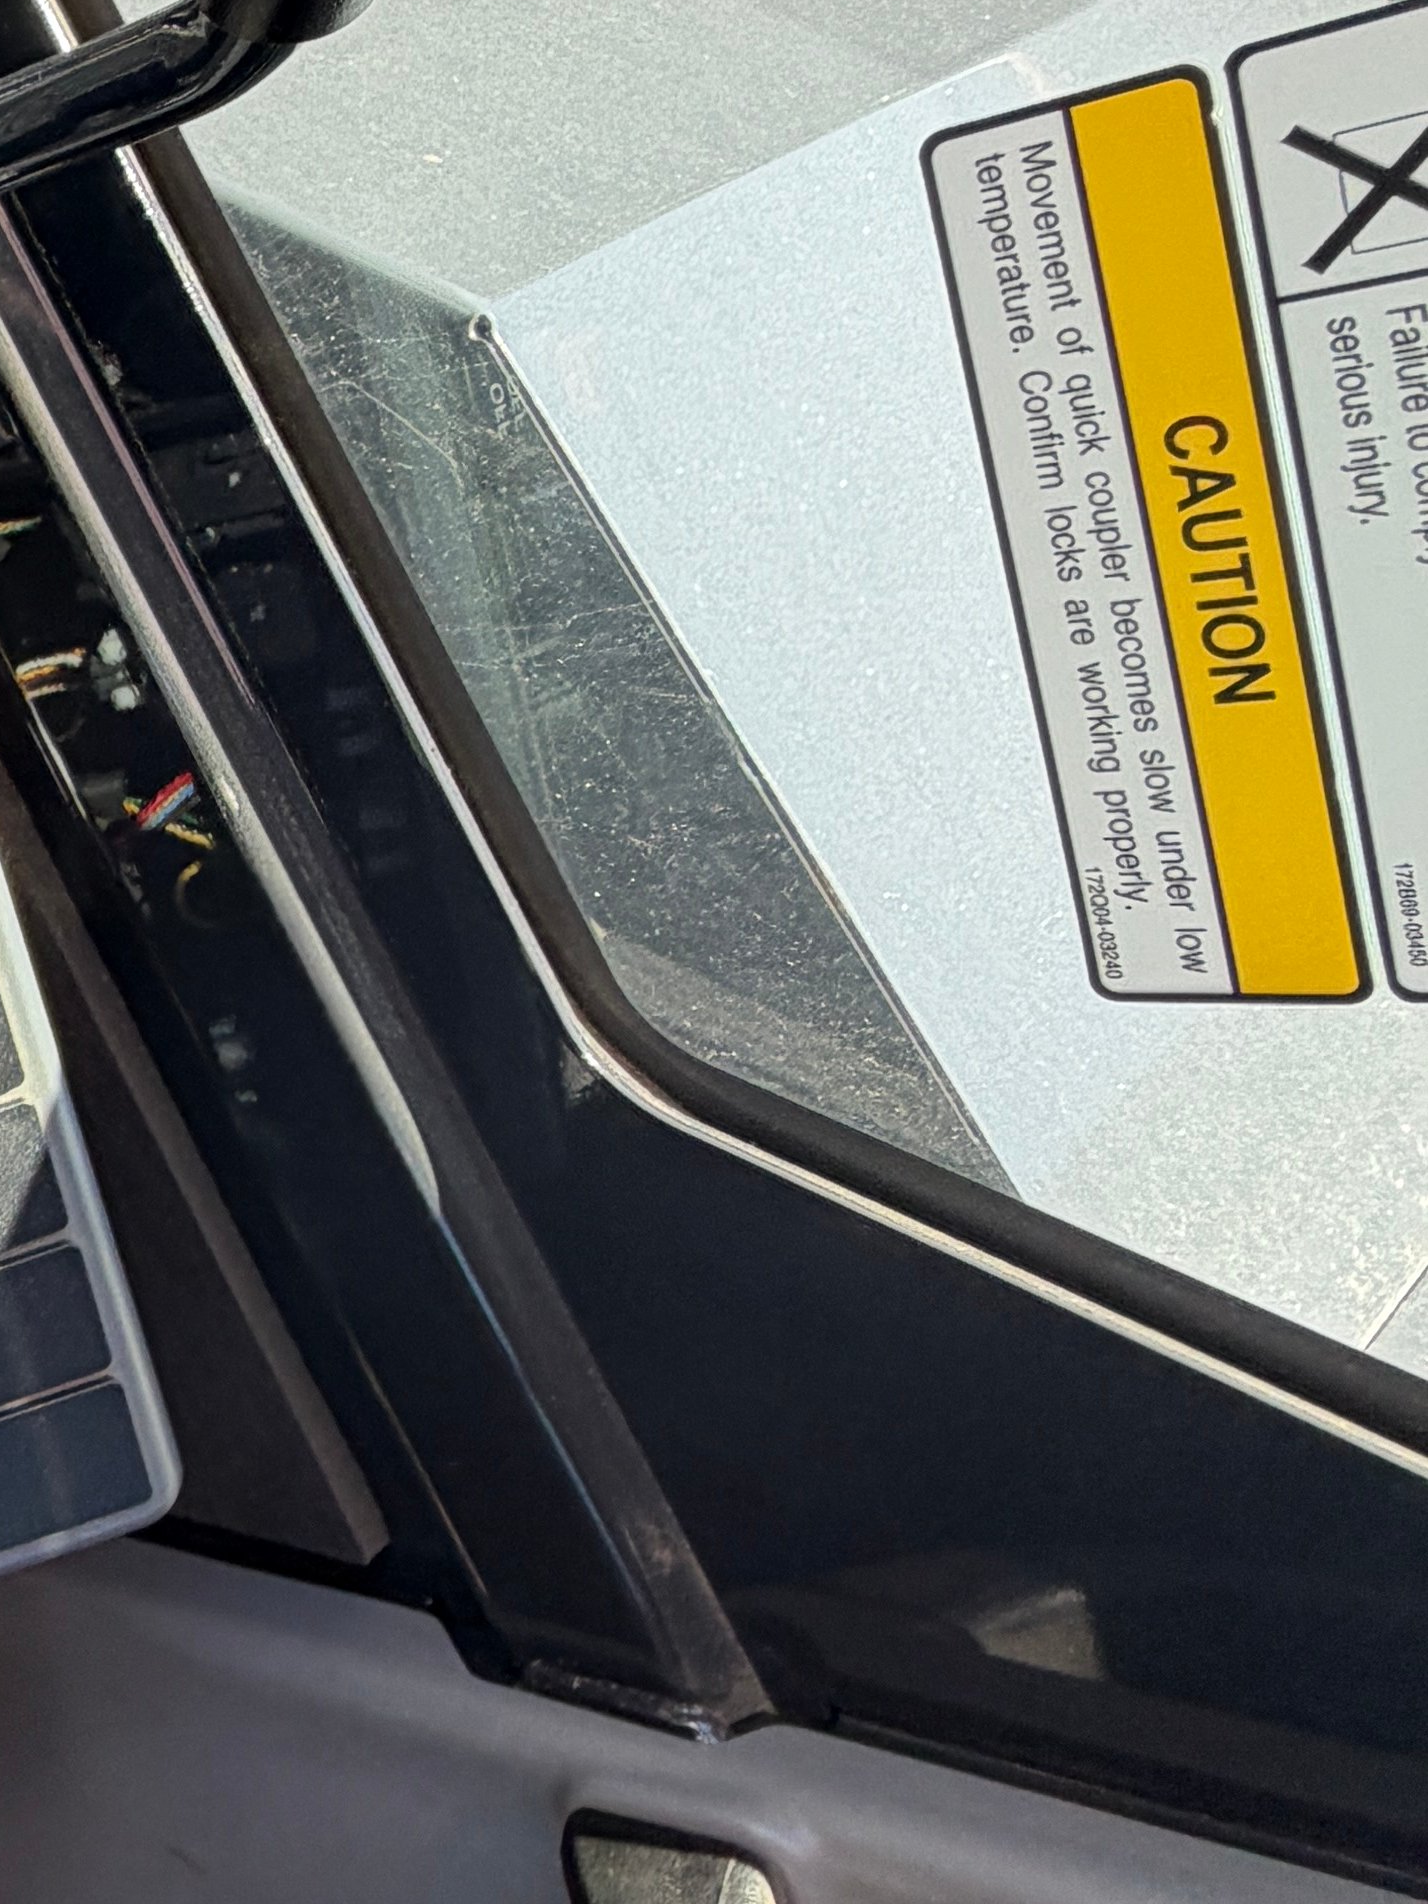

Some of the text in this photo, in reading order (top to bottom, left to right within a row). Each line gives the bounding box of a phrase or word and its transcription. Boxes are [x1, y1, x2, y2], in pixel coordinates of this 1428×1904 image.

[1326, 315, 1392, 525] serious injury.
[1385, 303, 1428, 413] Failure
[974, 152, 1153, 910] temperature. Confirm locks are working properly.
[1019, 140, 1208, 974] Movement of quick coupler becomes slow under low
[1163, 414, 1276, 707] CAUTION
